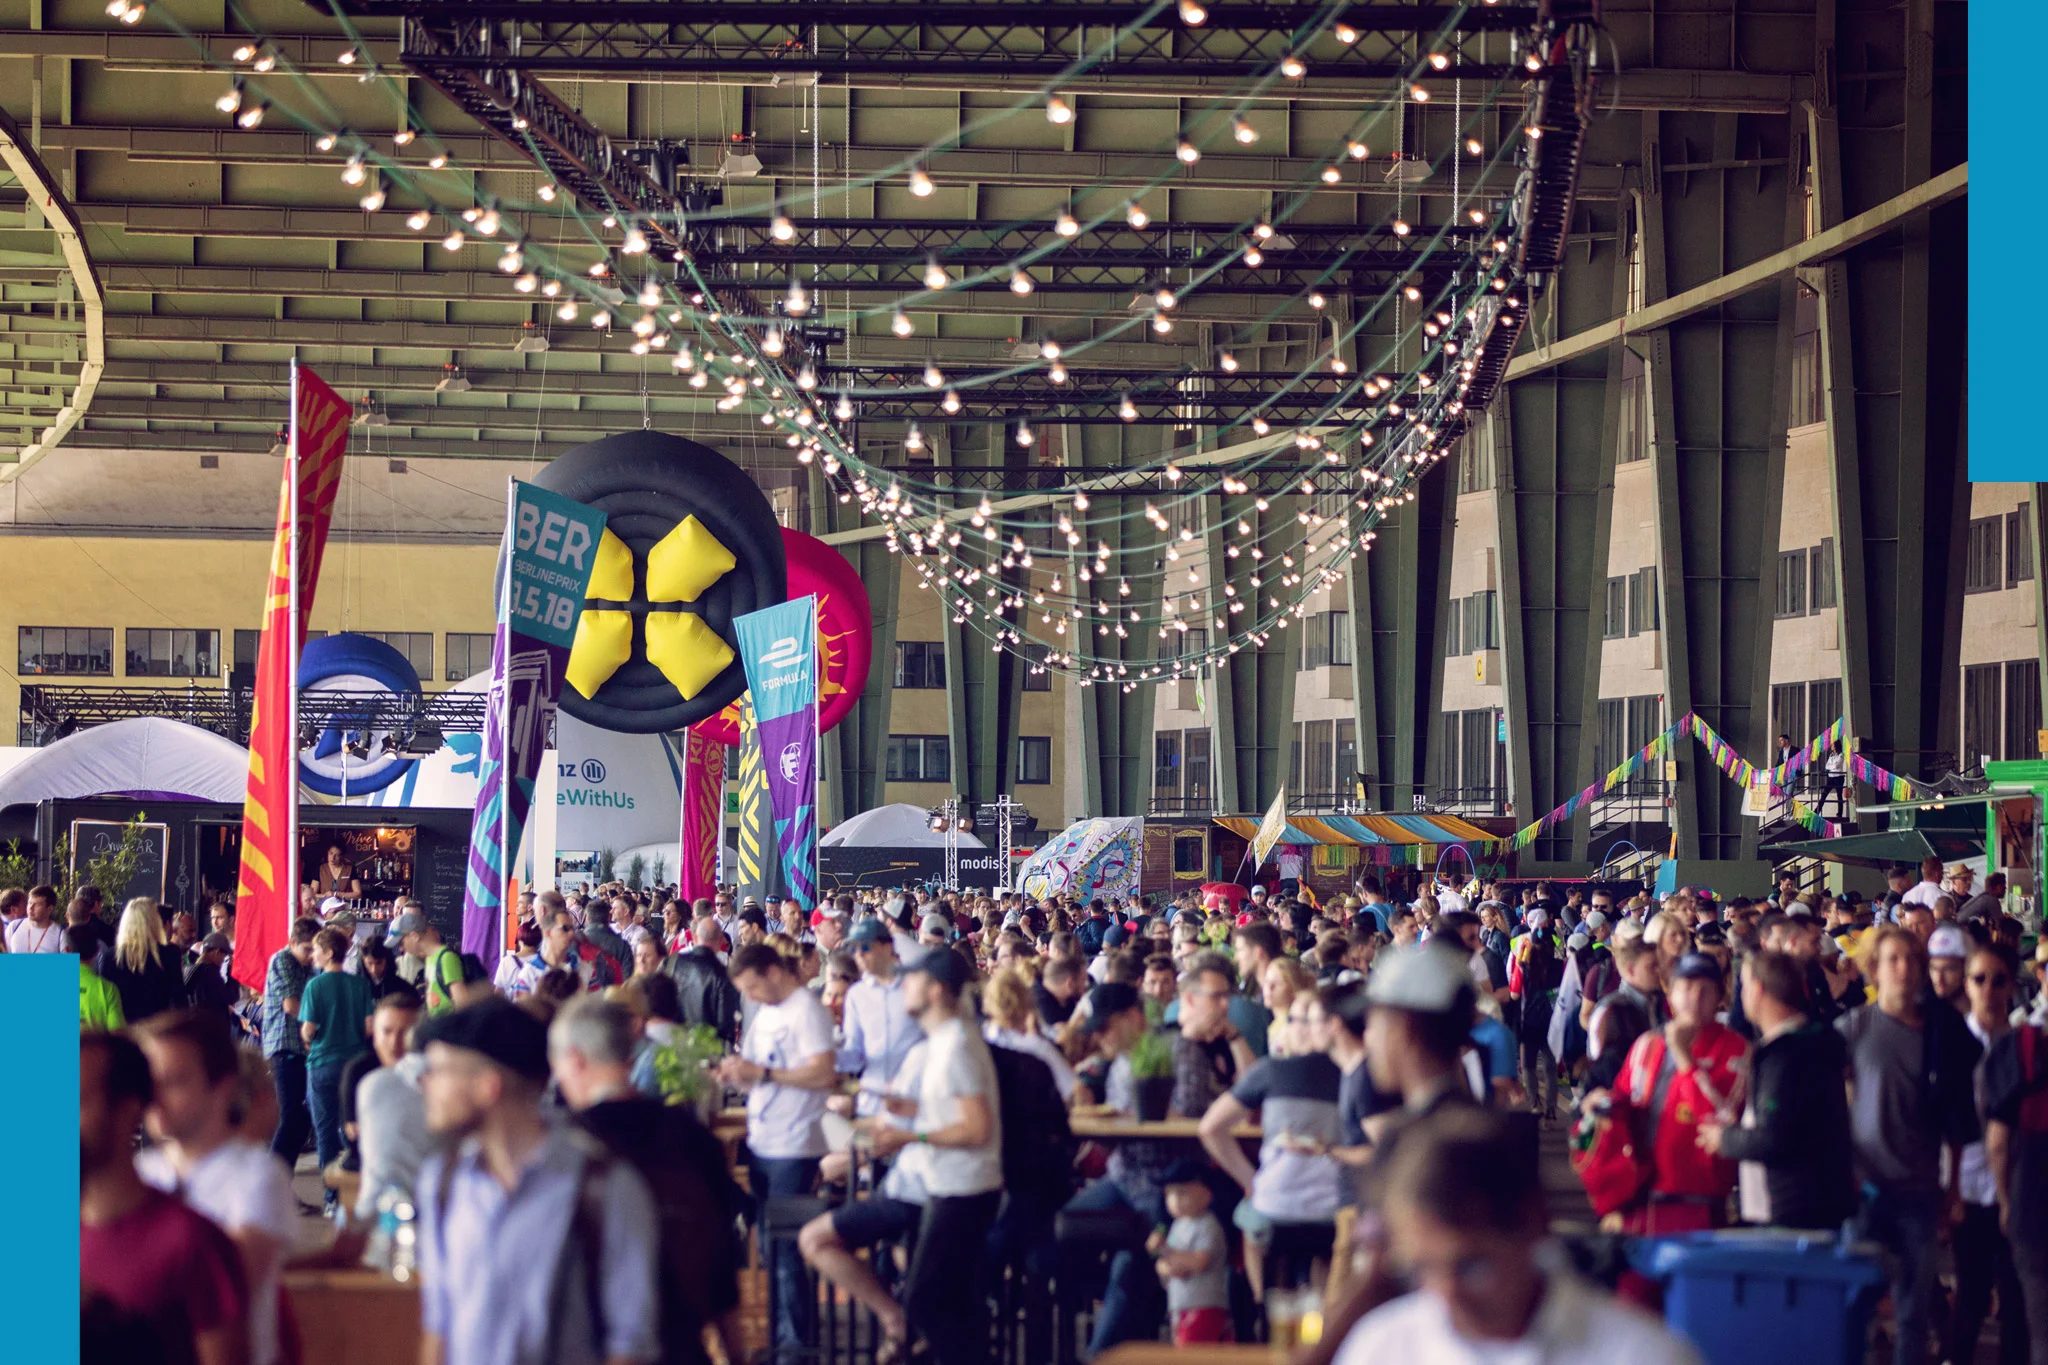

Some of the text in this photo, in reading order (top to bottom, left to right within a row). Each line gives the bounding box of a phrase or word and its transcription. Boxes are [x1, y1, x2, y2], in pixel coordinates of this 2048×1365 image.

[515, 500, 592, 571] BER
[761, 669, 808, 692] FORMULA
[355, 842, 373, 852] bar
[960, 855, 1000, 870] modis
